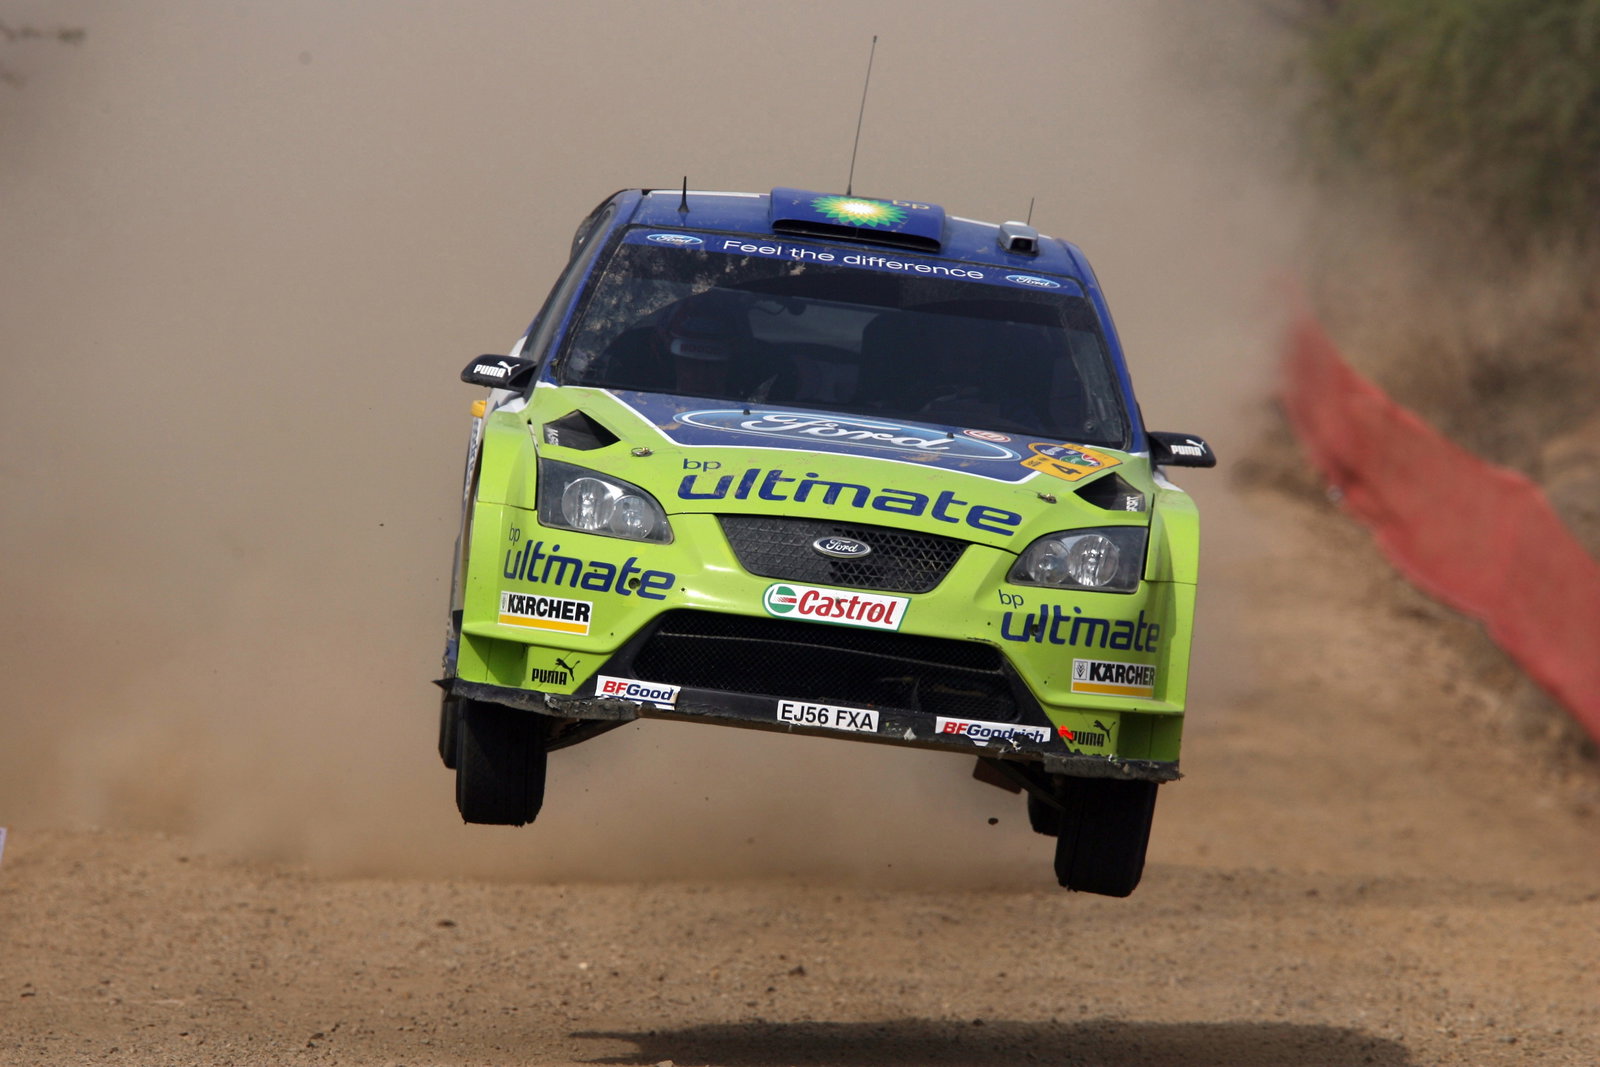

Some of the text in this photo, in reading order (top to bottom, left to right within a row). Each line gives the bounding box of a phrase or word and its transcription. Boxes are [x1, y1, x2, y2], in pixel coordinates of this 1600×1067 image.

[723, 240, 985, 280] Feel the difference
[473, 364, 506, 378] PUMA
[740, 414, 955, 450] Ford
[1171, 444, 1202, 456] PUMA
[682, 458, 722, 473] bp
[1051, 463, 1082, 475] 4
[677, 468, 1023, 537] ultimate
[508, 523, 521, 546] bp
[503, 539, 676, 601] ultimate
[507, 593, 591, 622] KÄRCHER
[798, 589, 898, 625] Castrol
[998, 589, 1025, 609] bp
[1000, 603, 1161, 653] ultimate
[531, 668, 568, 685] PUMA
[1089, 661, 1155, 686] KÄRCHER
[780, 703, 874, 730] EJ56 FXA
